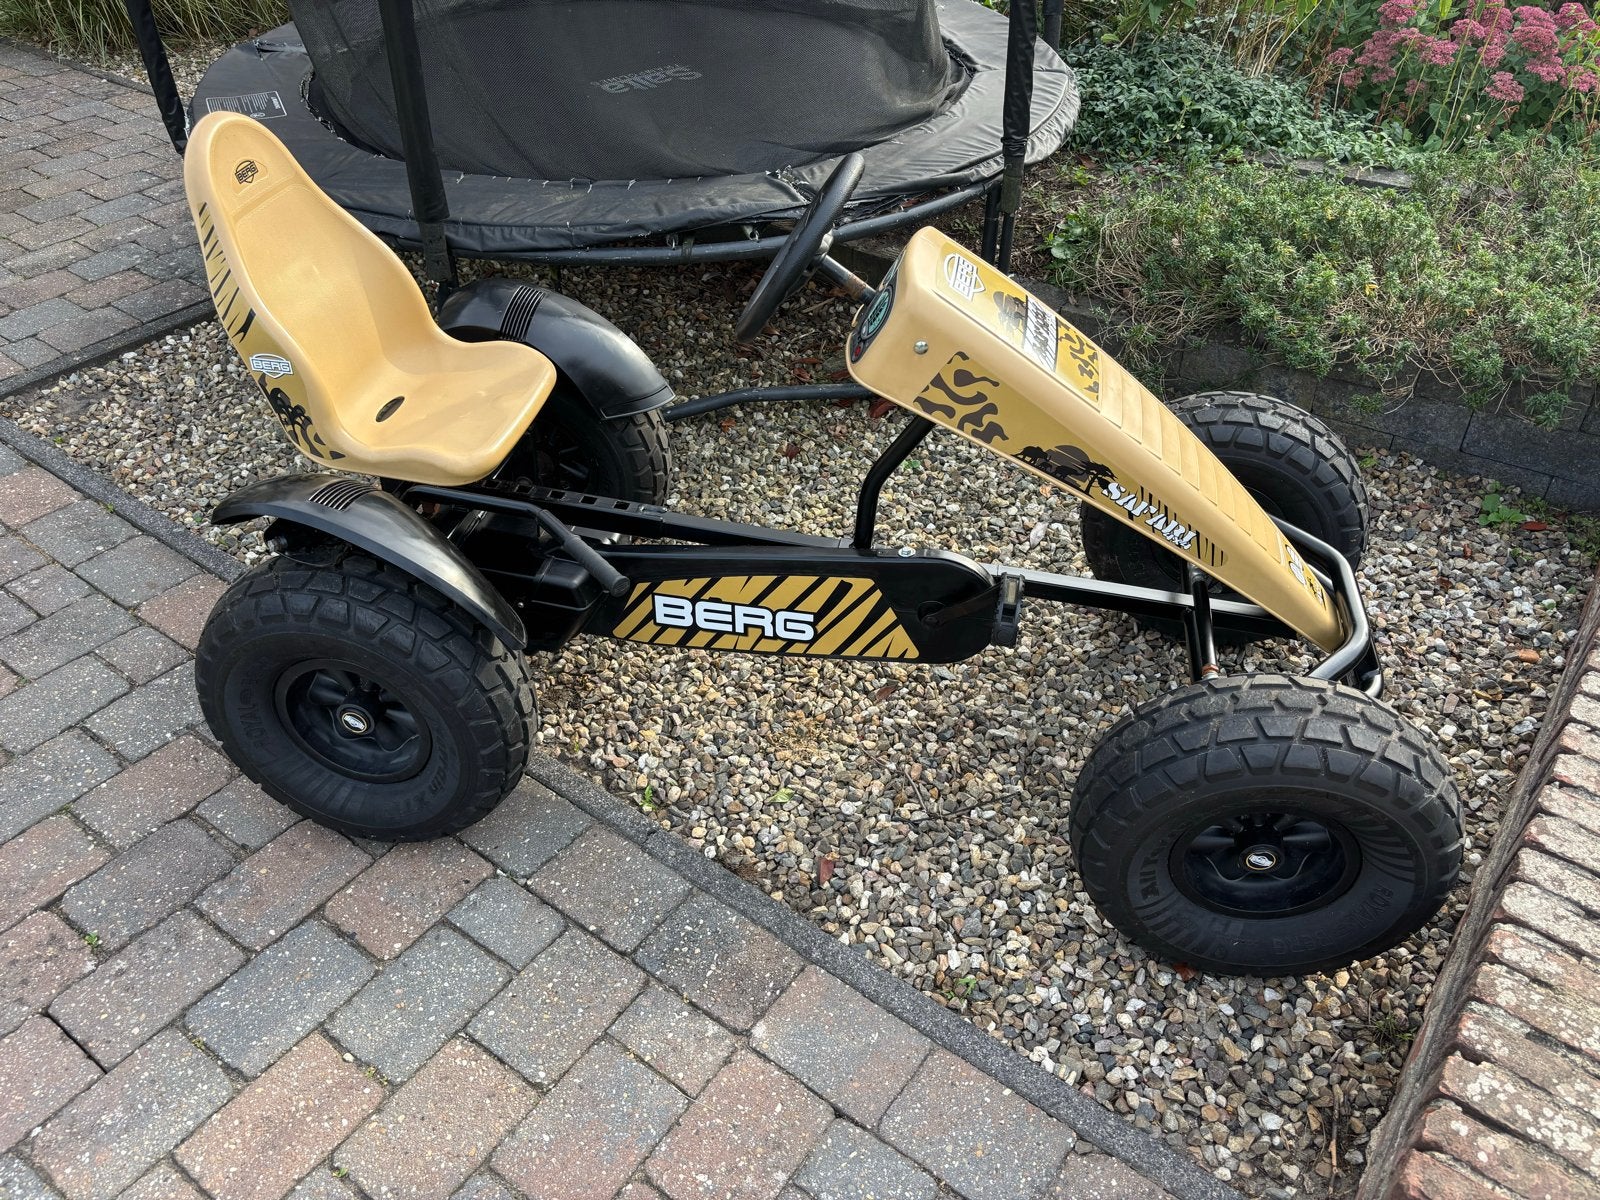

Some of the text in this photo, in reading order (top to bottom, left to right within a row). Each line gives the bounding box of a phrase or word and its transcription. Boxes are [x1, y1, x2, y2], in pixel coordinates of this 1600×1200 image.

[237, 163, 257, 182] BERG
[954, 257, 975, 298] BERG
[252, 360, 290, 372] BERG
[1101, 482, 1197, 543] SAFARI
[653, 594, 815, 641] BERG
